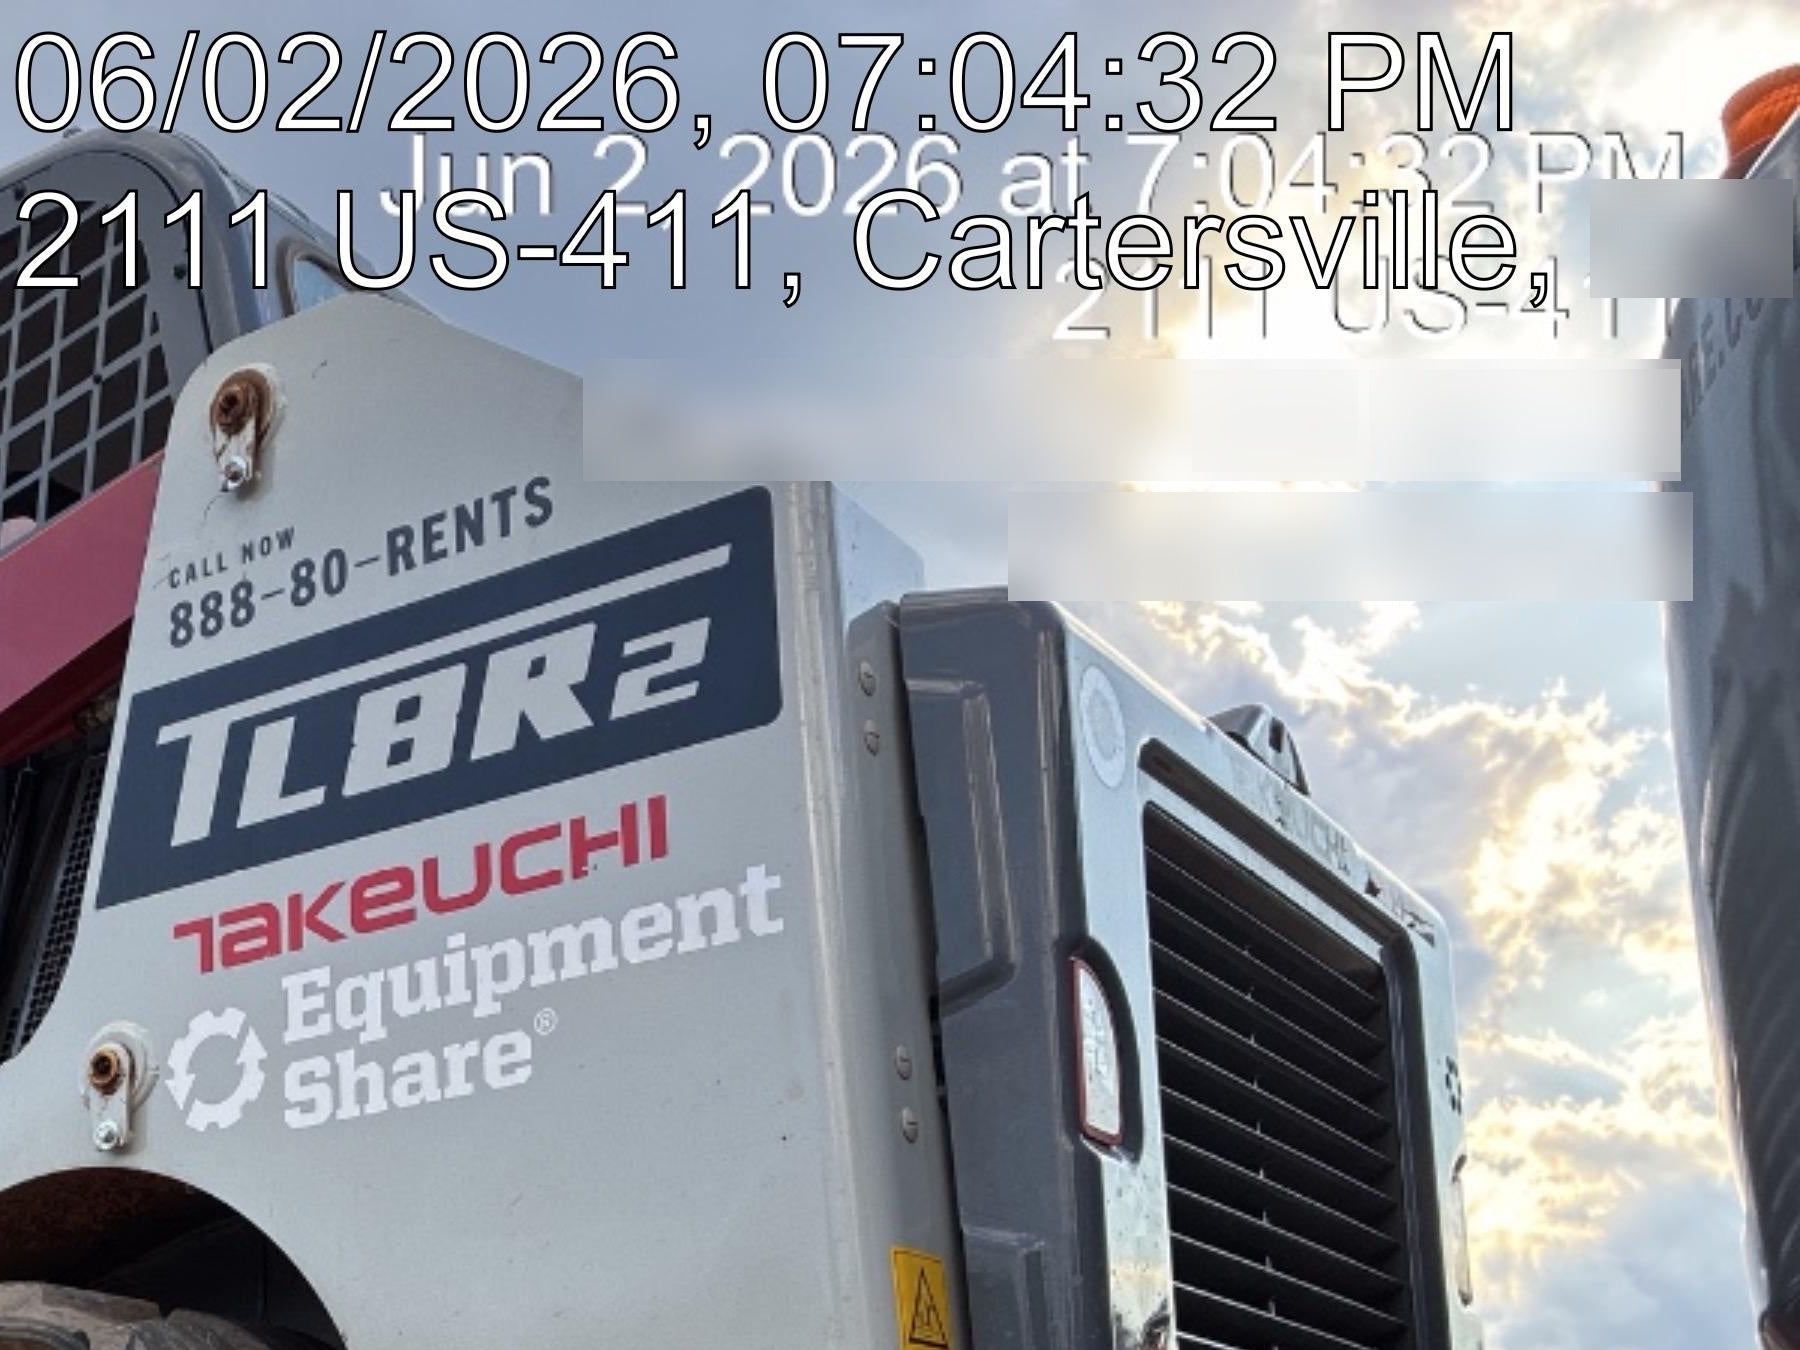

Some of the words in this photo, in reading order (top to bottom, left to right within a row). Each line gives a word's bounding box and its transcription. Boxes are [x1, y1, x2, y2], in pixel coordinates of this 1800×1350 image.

[169, 551, 228, 589] CALL
[242, 526, 296, 564] NOW
[169, 476, 554, 649] 888-80-RENTS
[282, 863, 784, 1044] Equipment
